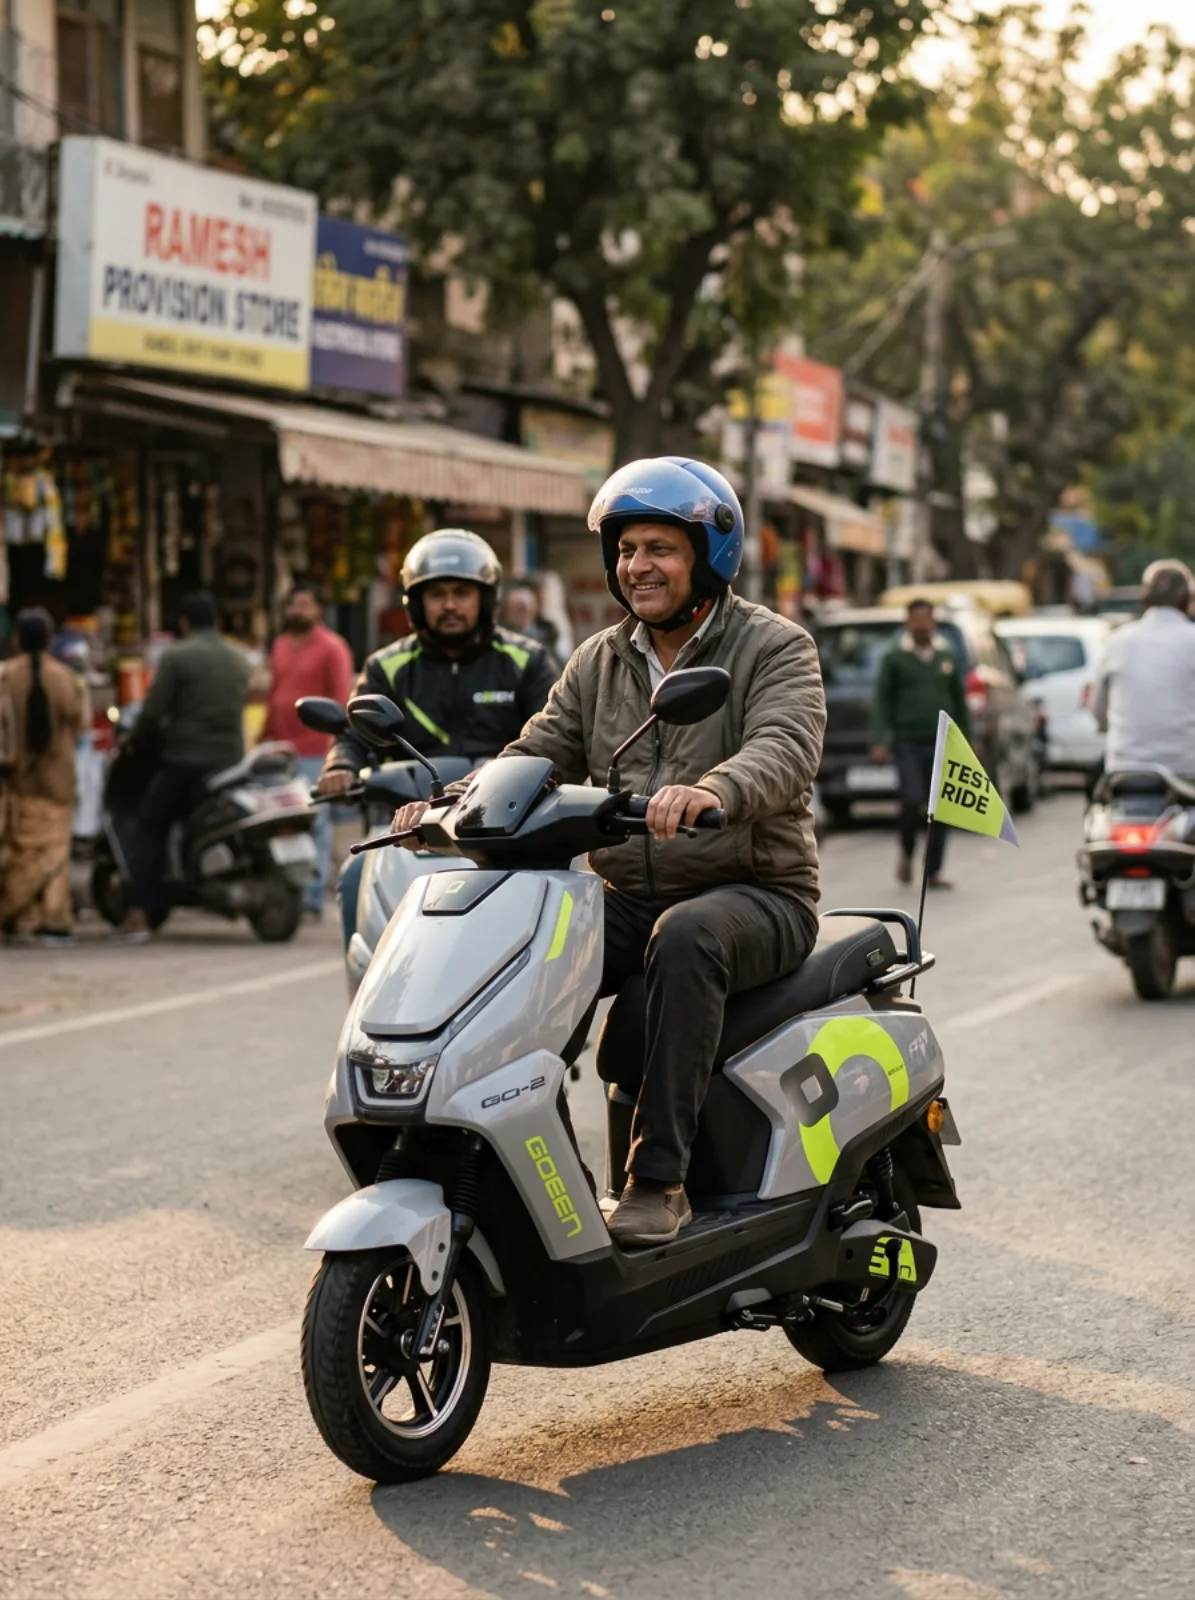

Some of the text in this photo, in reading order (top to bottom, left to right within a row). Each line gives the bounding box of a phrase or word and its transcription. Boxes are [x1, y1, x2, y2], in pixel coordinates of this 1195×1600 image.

[142, 201, 272, 281] RAMESH
[103, 265, 226, 327] PROVISION
[235, 289, 301, 341] STORE
[941, 781, 990, 815] RIDE
[947, 759, 991, 794] TEST
